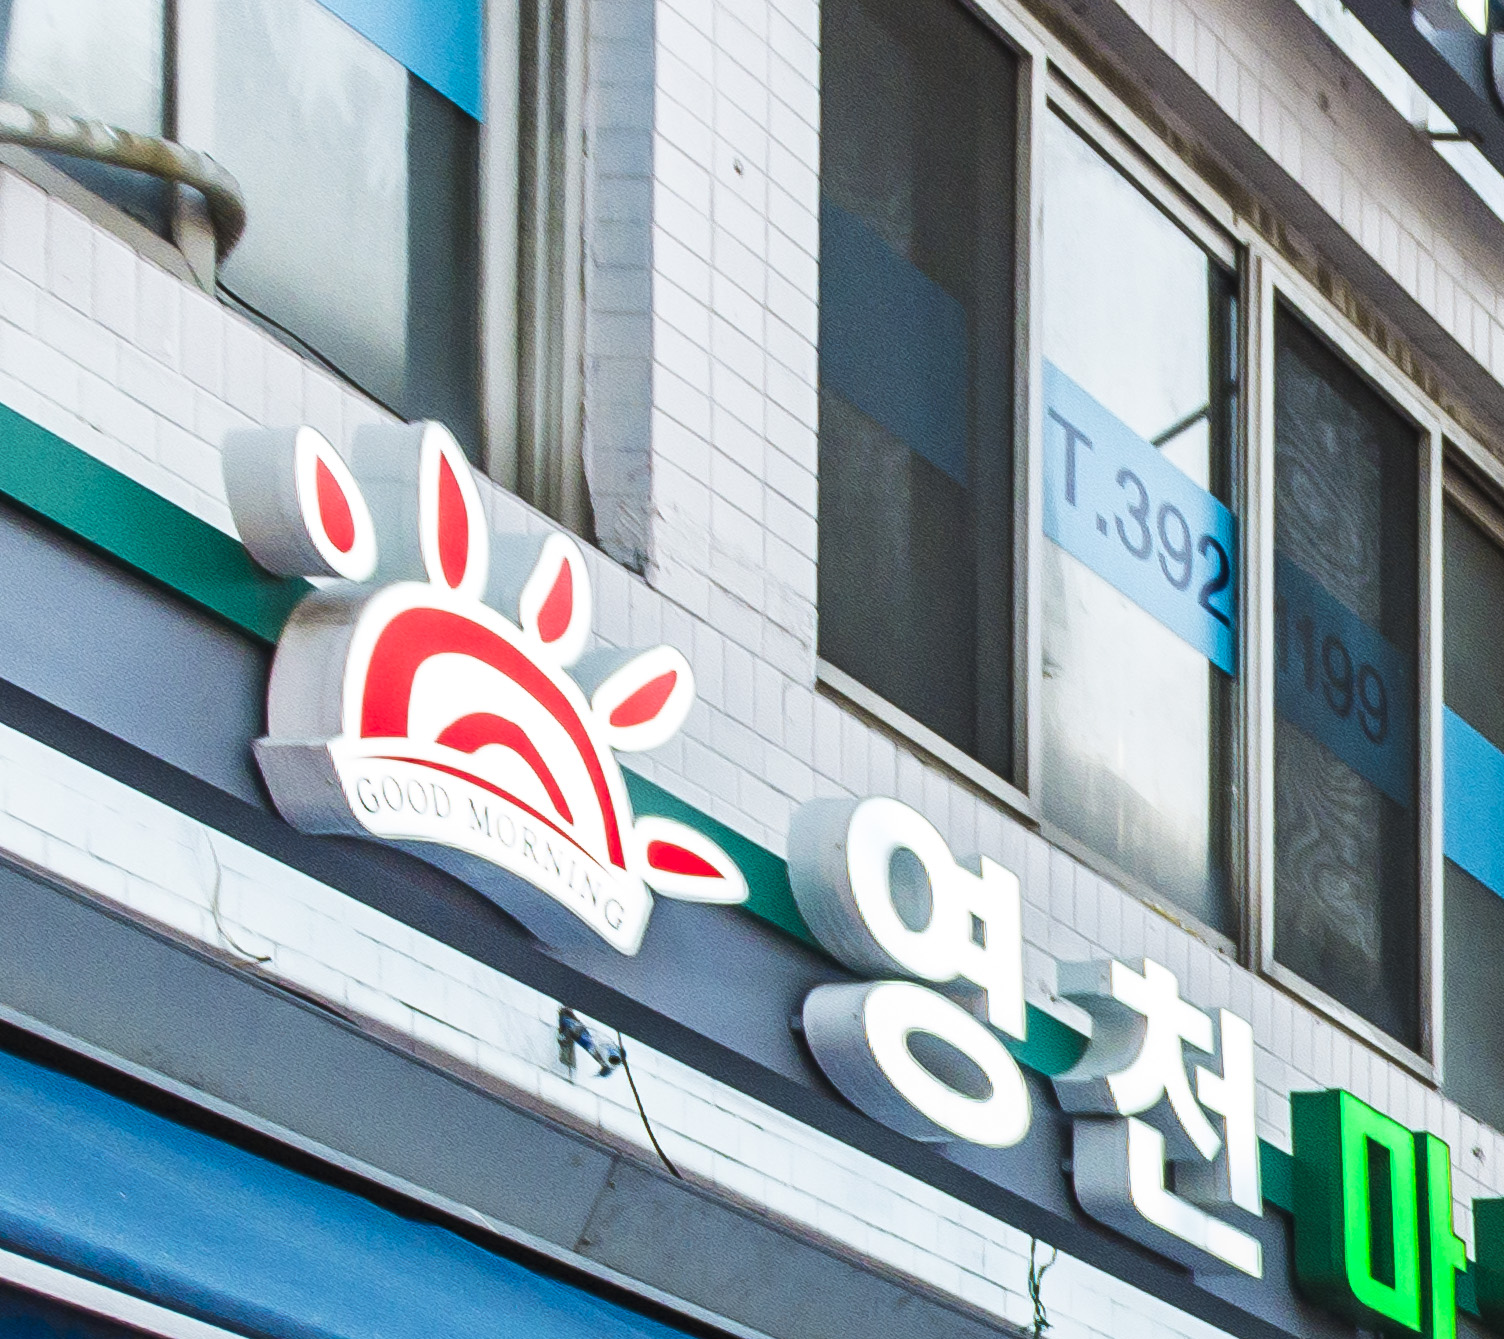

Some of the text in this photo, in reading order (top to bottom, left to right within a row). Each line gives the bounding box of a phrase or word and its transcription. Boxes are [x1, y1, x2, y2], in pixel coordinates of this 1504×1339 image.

[356, 774, 626, 932] GOOD MORNING
[838, 803, 1264, 1280] 영천
